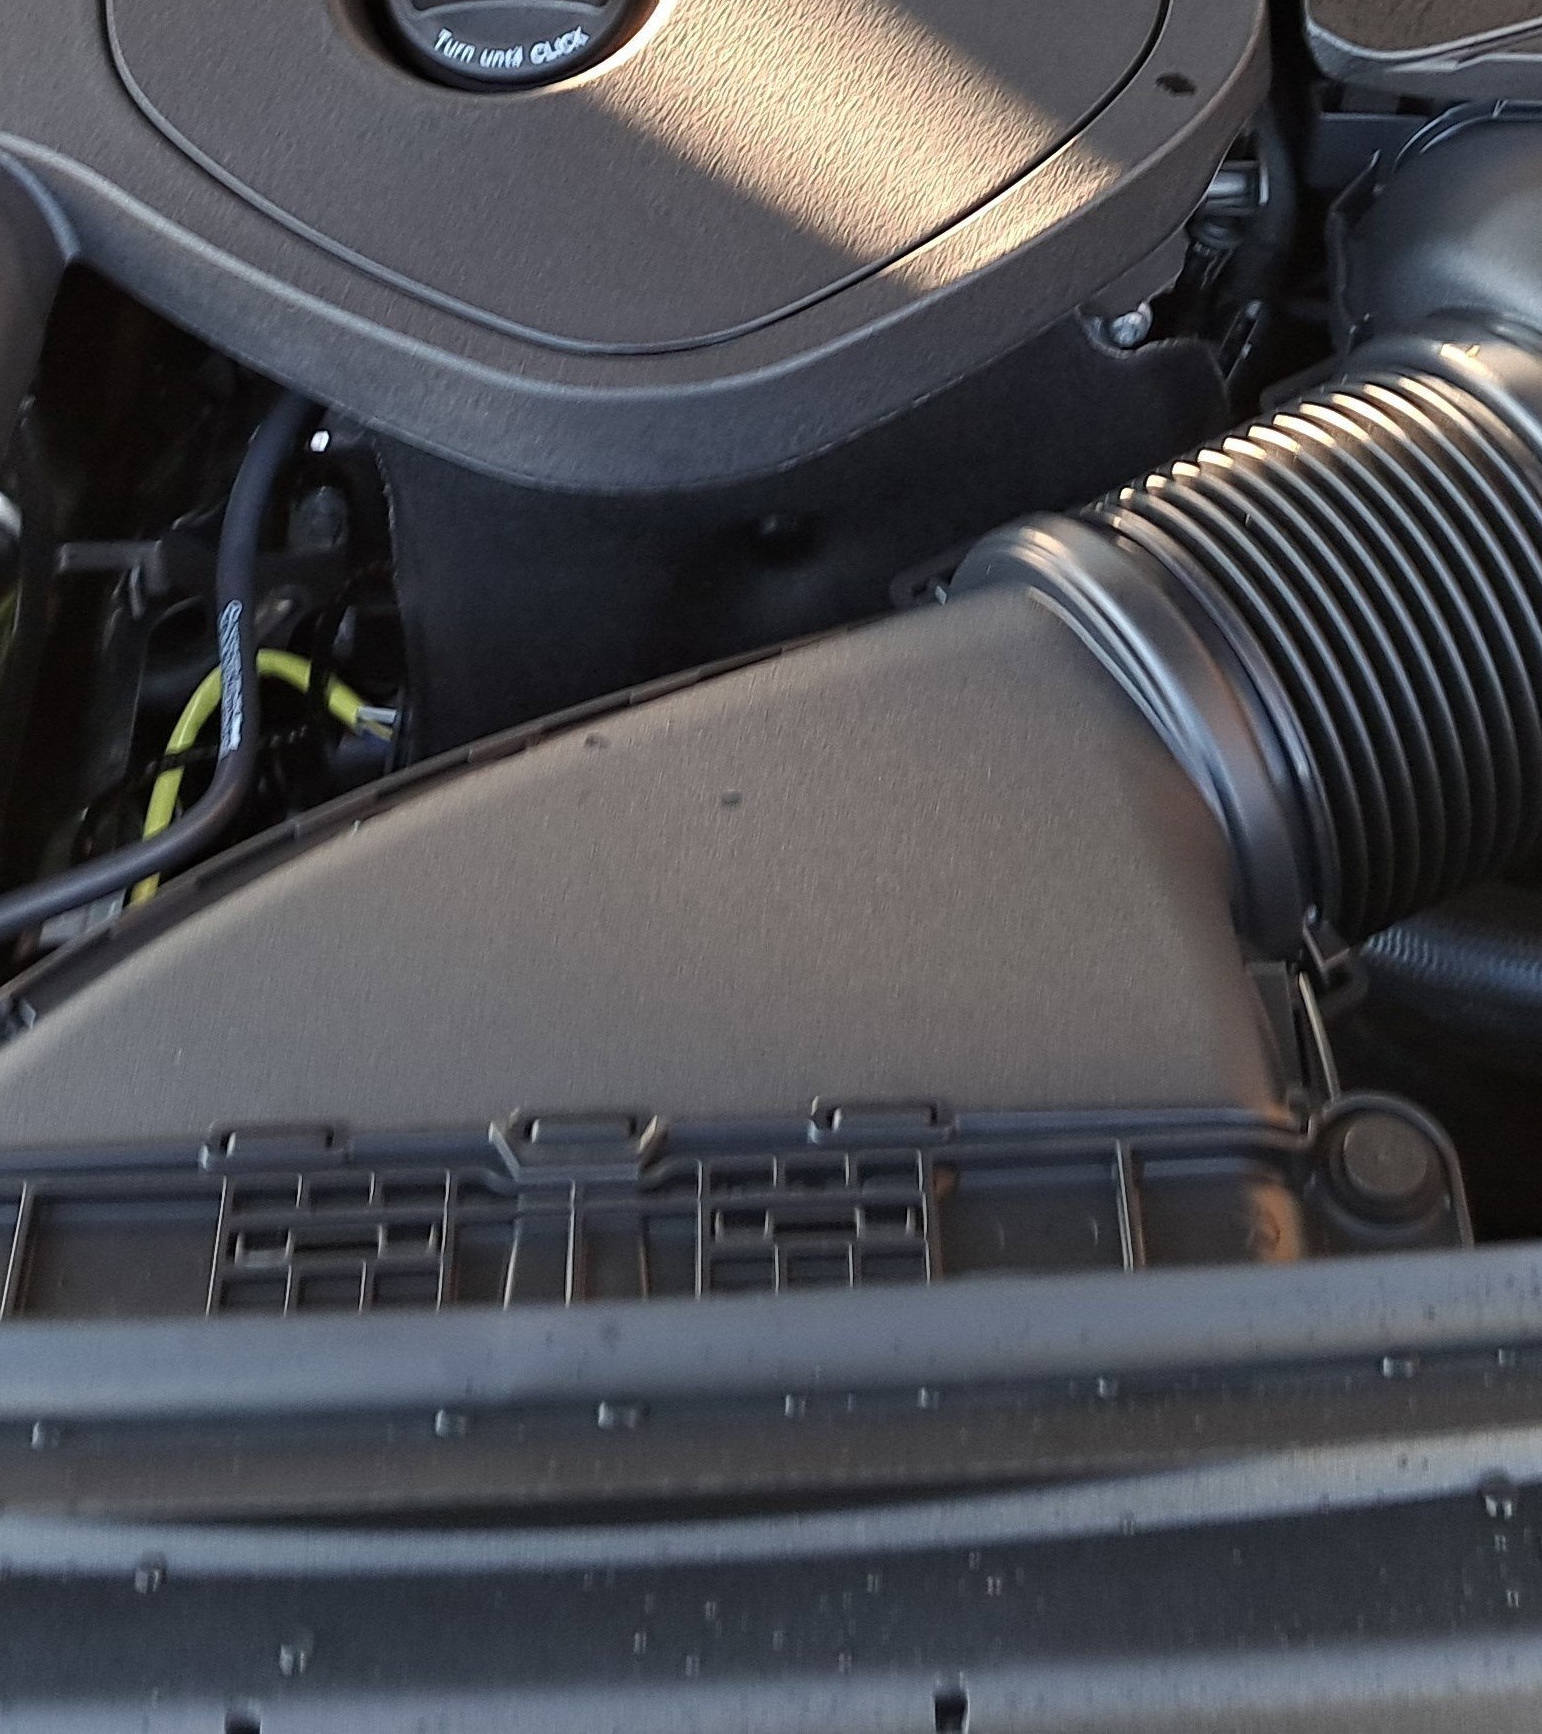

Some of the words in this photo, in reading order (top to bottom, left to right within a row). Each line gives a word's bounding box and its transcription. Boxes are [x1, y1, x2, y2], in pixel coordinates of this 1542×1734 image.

[434, 28, 476, 64] Turn
[480, 45, 525, 68] until
[530, 26, 590, 65] CLICK
